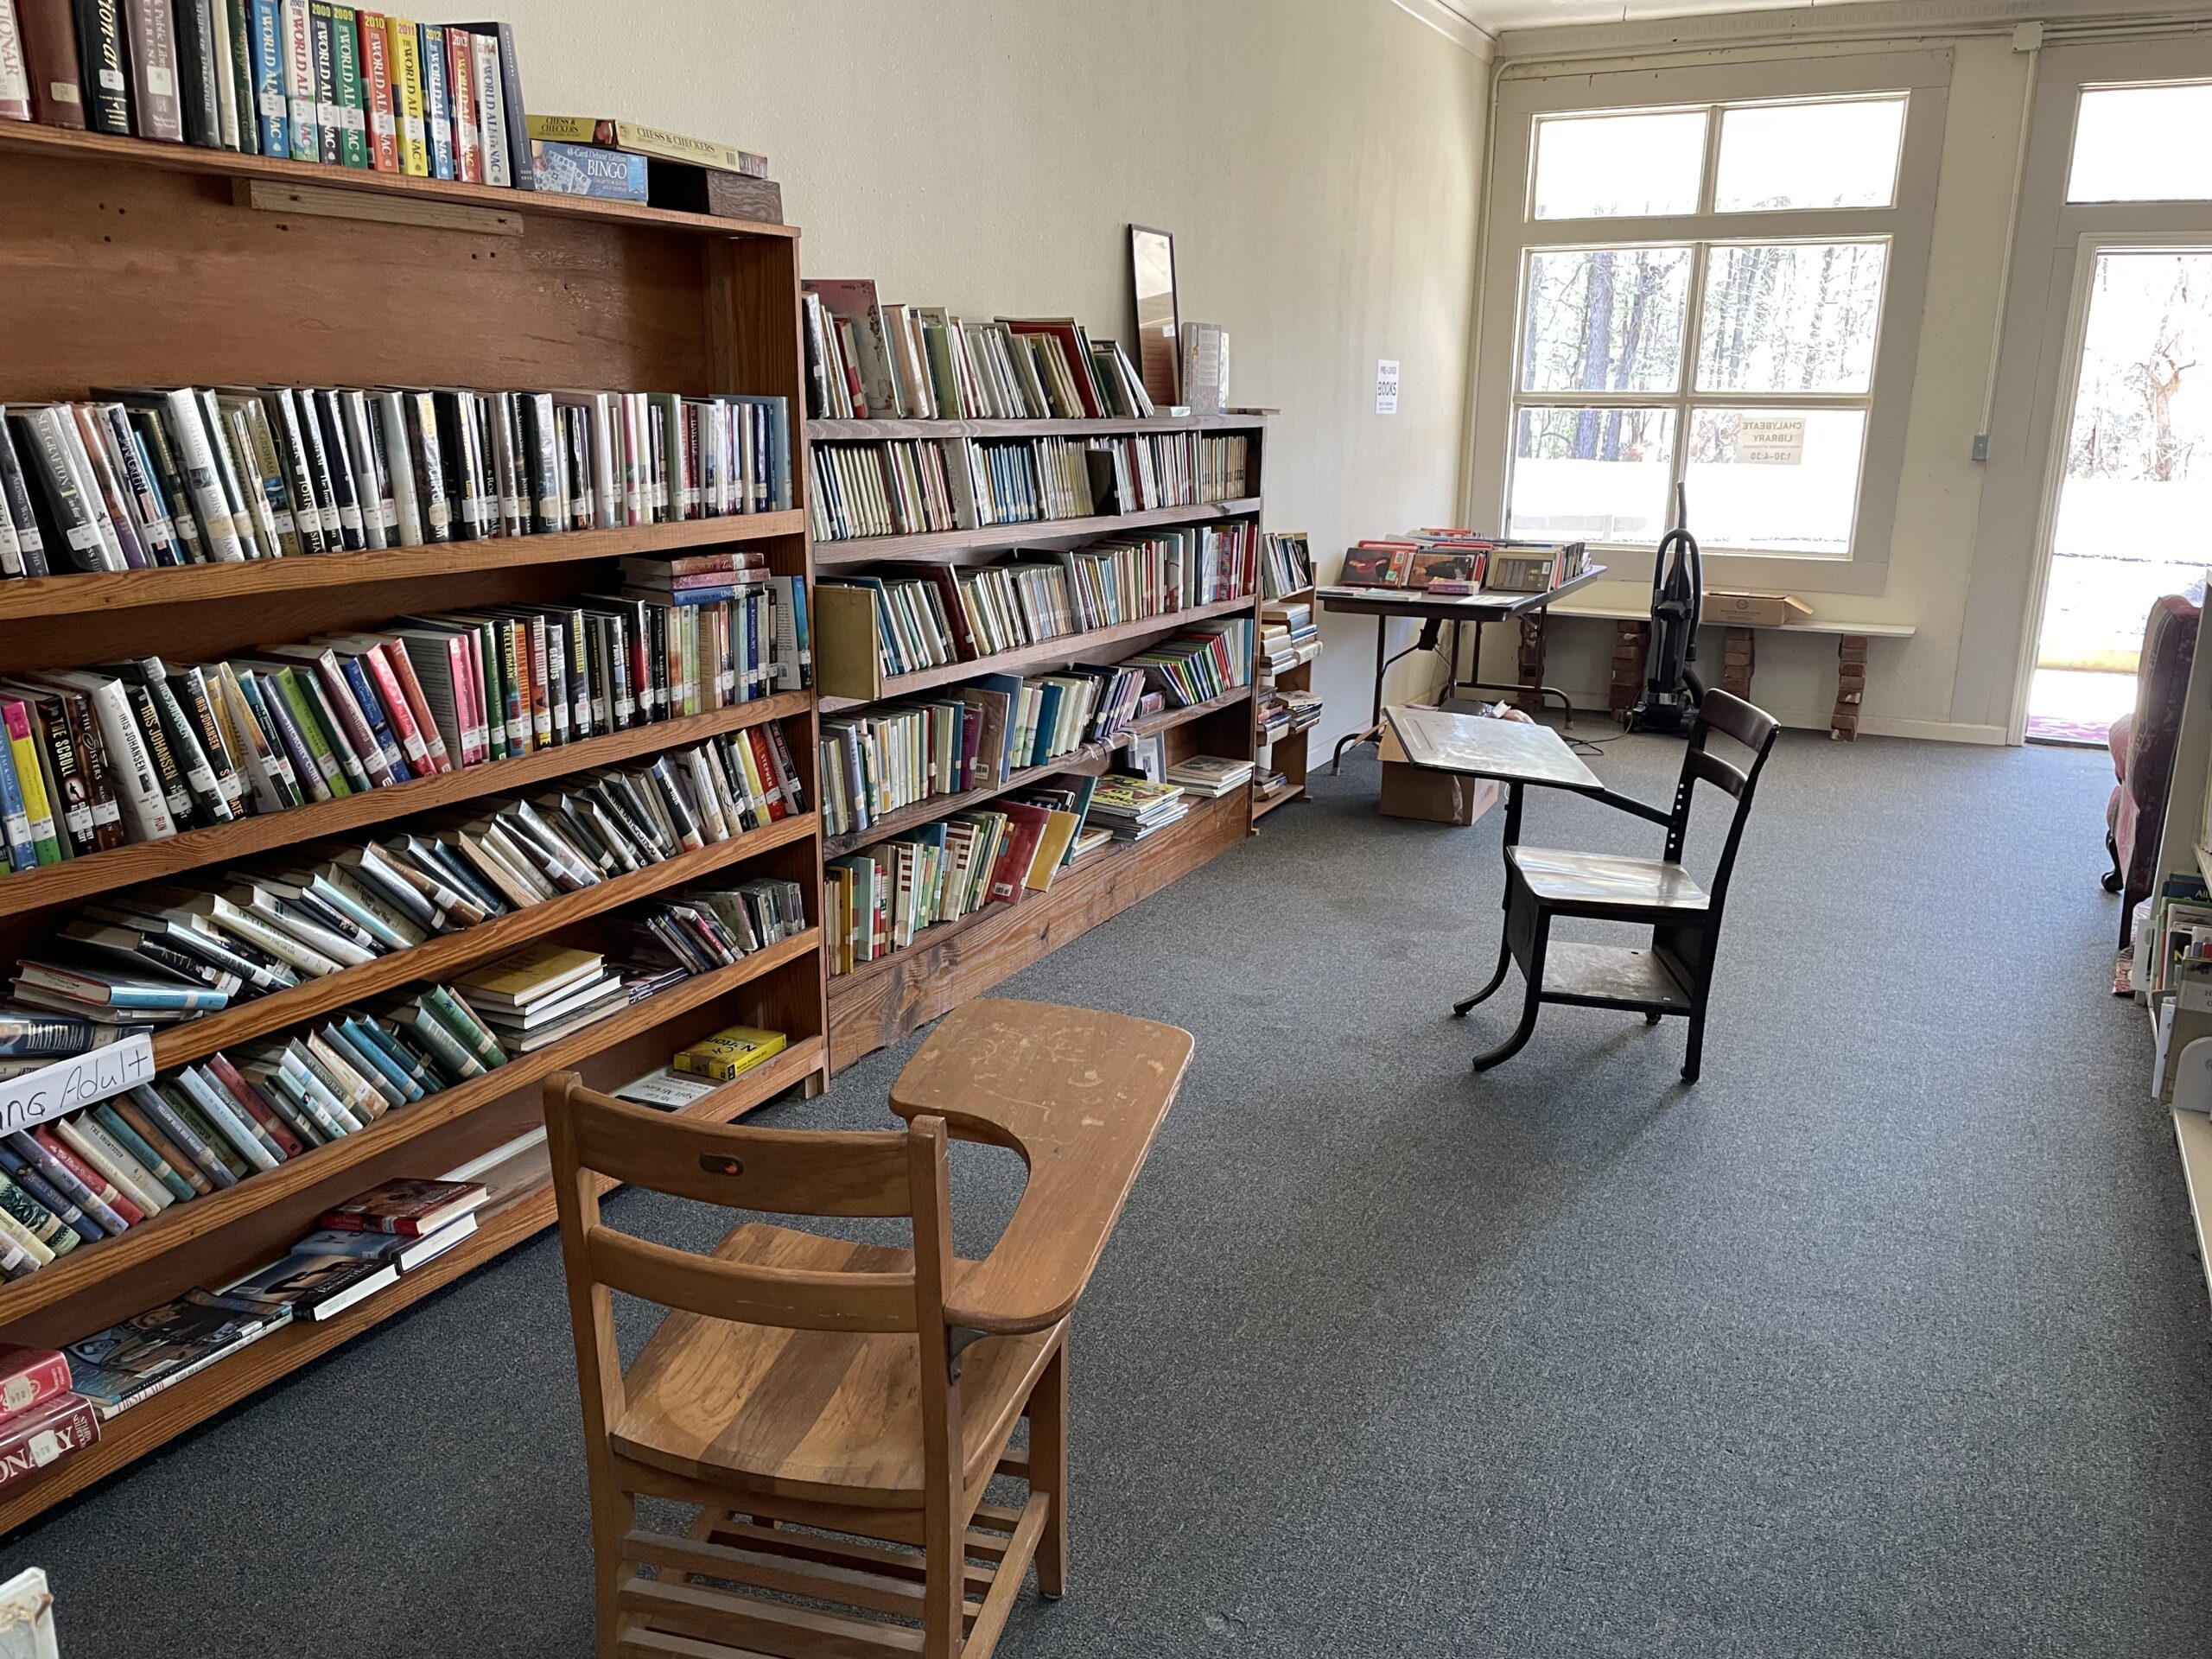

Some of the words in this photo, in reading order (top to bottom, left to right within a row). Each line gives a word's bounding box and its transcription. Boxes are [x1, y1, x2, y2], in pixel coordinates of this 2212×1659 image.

[312, 3, 331, 17] 2009
[334, 8, 353, 21] 2009
[365, 16, 385, 29] 2010
[260, 14, 276, 67] WORLD
[292, 17, 308, 71] WORLD
[397, 23, 415, 36] 2011
[426, 29, 442, 41] 2012
[452, 35, 468, 47] 2013
[316, 29, 330, 79] WORLD
[338, 33, 353, 82] WORLD
[371, 40, 385, 88] WORLD
[402, 47, 416, 95] WORLD
[429, 51, 442, 99] WORLD
[482, 64, 495, 110] WORLD
[542, 124, 579, 133] CHECKERS
[637, 128, 664, 143] CHESS
[673, 137, 714, 153] CHECKERS
[588, 160, 627, 178] BINGO
[589, 150, 607, 160] Deluxe
[608, 153, 626, 162] Edition
[1378, 382, 1396, 396] BOOKS
[34, 412, 51, 436] SUE
[41, 435, 72, 487] GRAFTON
[118, 435, 136, 461] JANE
[257, 429, 276, 475] GRISHAM
[126, 458, 148, 491] GREEN
[58, 483, 79, 503] T
[206, 486, 224, 513] JOHN
[298, 479, 313, 510] JOHN
[503, 625, 513, 678] KELLERMAN
[548, 647, 559, 679] GENIUS
[158, 683, 173, 701] IRIS
[194, 695, 208, 714] IRIS
[79, 711, 92, 731] THE
[118, 712, 131, 730] IRIS
[165, 696, 191, 740] JOHANSEN
[198, 711, 220, 750] JOHANSEN
[80, 730, 108, 781] SISTERS
[123, 730, 148, 772] JOHANSEN
[139, 704, 157, 727] IRIS
[148, 726, 178, 780] JOHANSEN
[284, 720, 309, 761] HICKORY
[0, 754, 15, 791] JACKSON
[54, 739, 76, 777] SCROLL
[759, 753, 774, 787] STEPHEN
[152, 815, 168, 832] RUN
[704, 1037, 758, 1052] Norton
[60, 1050, 149, 1108] Adult
[304, 1057, 315, 1067] MY
[312, 1065, 332, 1084] FRIEND
[213, 1086, 232, 1104] Saying
[227, 1099, 248, 1119] Goodbye
[89, 1124, 101, 1136] THE
[155, 1104, 174, 1122] YELLOW
[169, 1119, 182, 1132] BLUE
[179, 1128, 190, 1140] BUS
[27, 1173, 50, 1194] HOLLY
